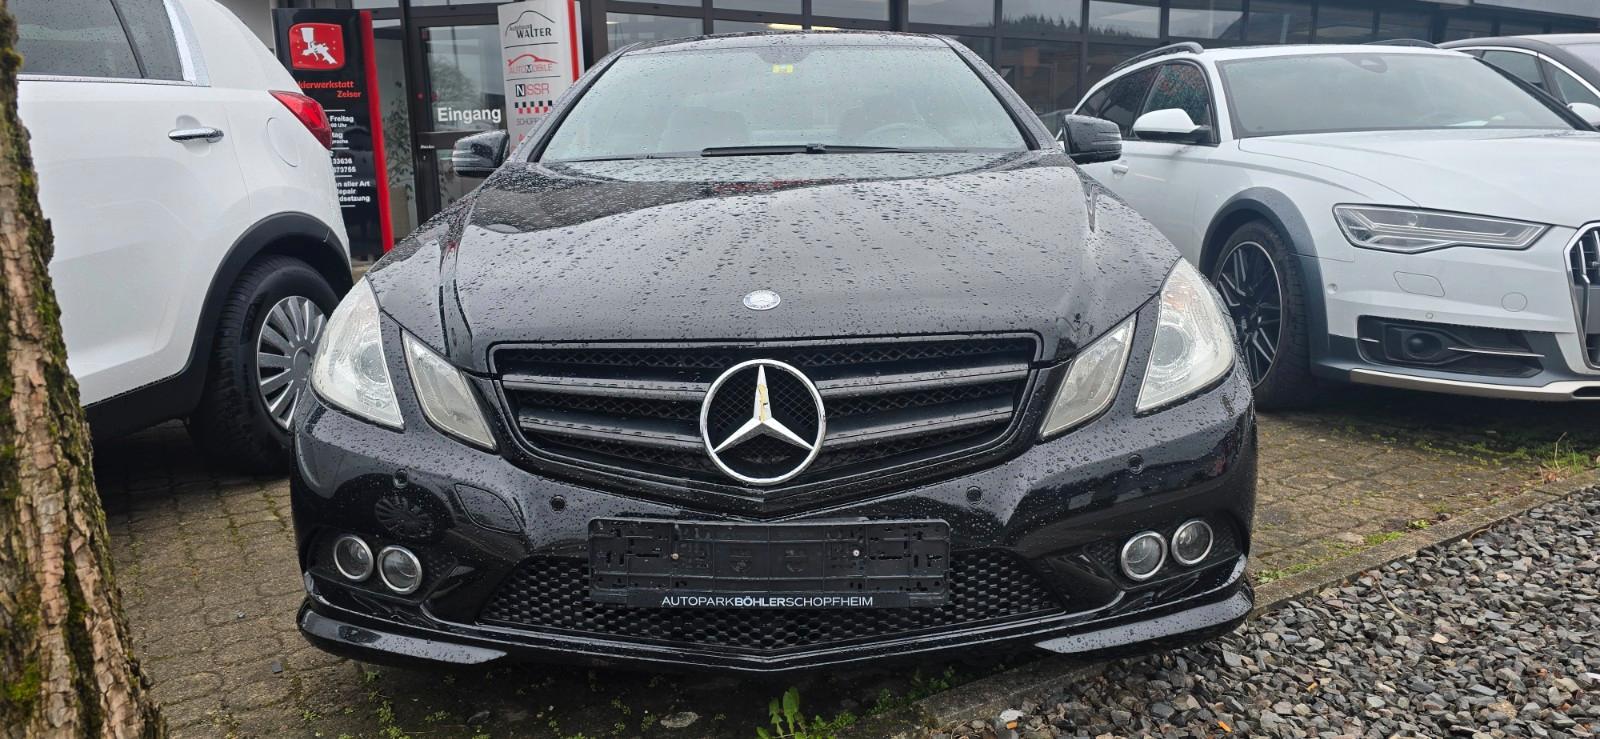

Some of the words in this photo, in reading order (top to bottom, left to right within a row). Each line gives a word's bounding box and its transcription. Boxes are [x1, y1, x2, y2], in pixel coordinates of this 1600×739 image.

[516, 24, 552, 38] WALTER
[330, 115, 354, 123] Freitag
[437, 107, 501, 124] Eingang
